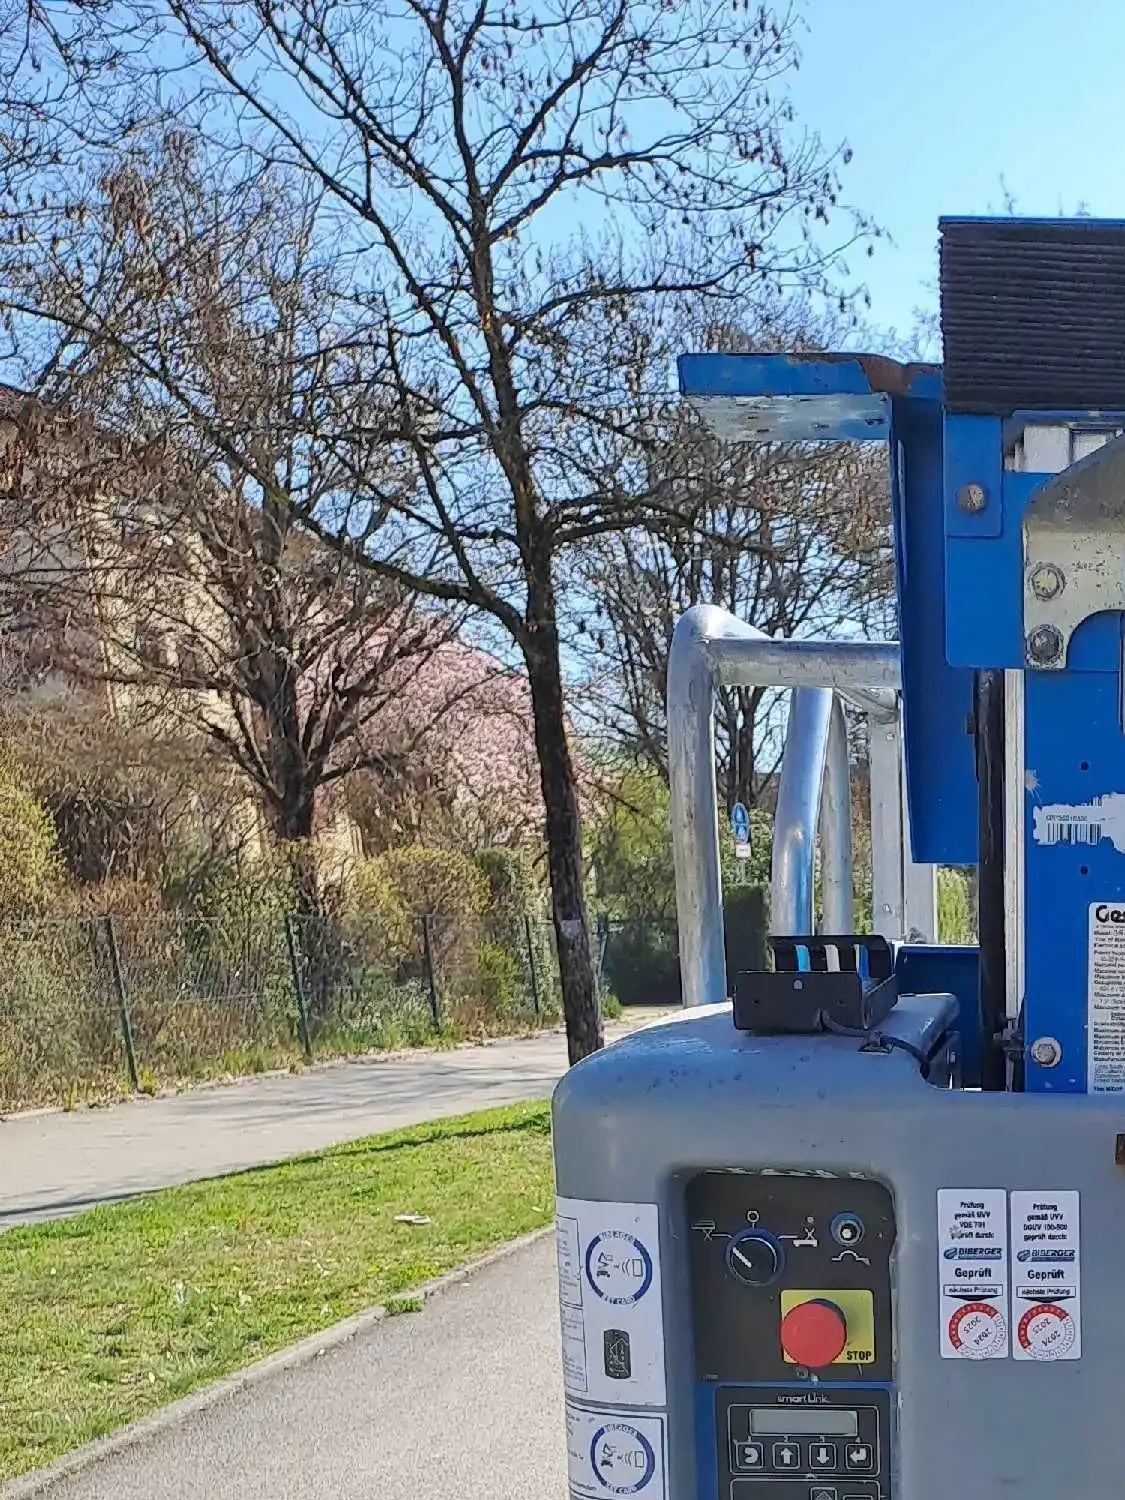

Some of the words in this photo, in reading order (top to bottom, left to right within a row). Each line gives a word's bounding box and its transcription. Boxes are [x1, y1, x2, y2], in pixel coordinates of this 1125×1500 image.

[954, 1266, 992, 1280] Geprüft
[1027, 1269, 1065, 1281] Geprüft
[846, 1350, 872, 1361] STOP
